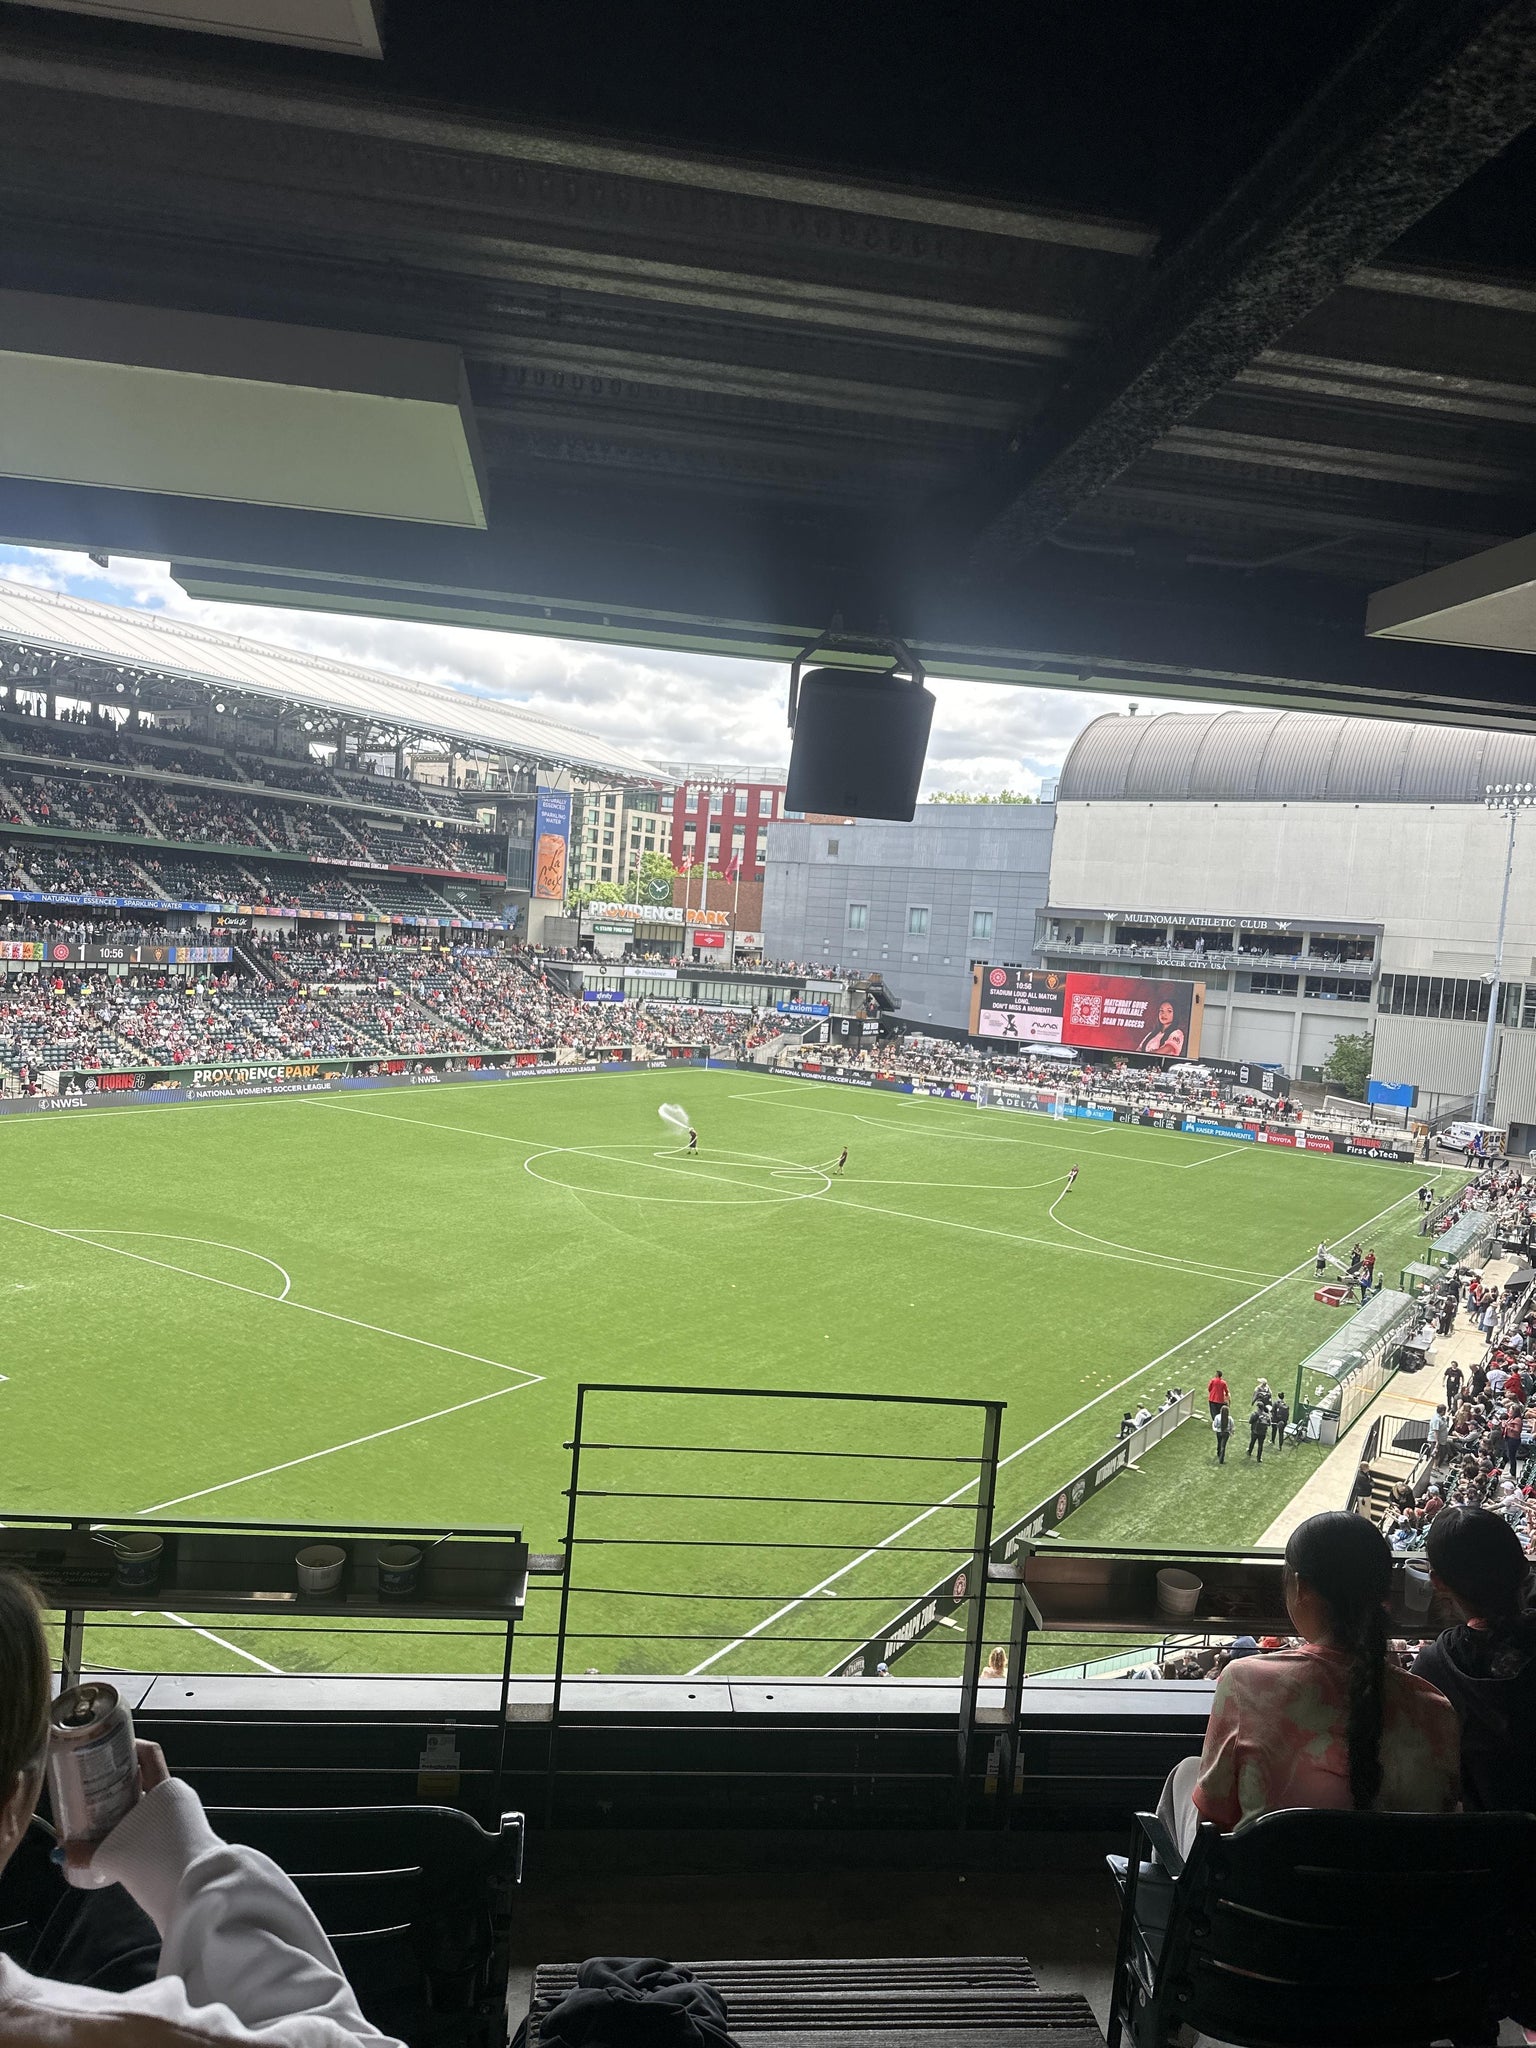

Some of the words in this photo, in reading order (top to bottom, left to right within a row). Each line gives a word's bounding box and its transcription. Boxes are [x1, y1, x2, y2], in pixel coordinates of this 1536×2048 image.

[350, 860, 370, 868] CHRISTINE
[42, 894, 80, 903] NATURALLY
[84, 896, 118, 905] ESSENCED
[124, 900, 158, 908] SPARKLING
[161, 902, 183, 910] WATER
[588, 900, 684, 922] PROVIDENCE
[686, 908, 730, 926] PARK
[1124, 913, 1186, 925] MULTNOMAH
[1190, 917, 1236, 928] ATHLETIC
[1240, 920, 1268, 929] CLUB
[100, 948, 124, 959] 10:56
[1156, 959, 1186, 967] SOCCER
[1189, 960, 1207, 969] CITY
[1016, 982, 1032, 990] 10:56
[596, 992, 612, 1000] xfinity
[990, 988, 1012, 996] STADIUM
[1013, 990, 1027, 998] LOUD
[790, 1004, 812, 1012] axiom
[1104, 998, 1132, 1008] MATCHDAY
[1132, 1000, 1148, 1010] GUIDE
[1103, 1006, 1116, 1014] NOW
[1116, 1007, 1144, 1016] AVAILABLE
[1102, 1017, 1116, 1025] SCAN
[1117, 1018, 1124, 1026] TO
[1124, 1019, 1145, 1028] ACCESS
[193, 1066, 284, 1082] PROVIDENCE
[285, 1064, 320, 1078] PARK
[774, 1068, 800, 1077] NATIONAL
[801, 1072, 826, 1080] WOMEN'S
[849, 1078, 872, 1086] LEAGUE
[96, 1073, 134, 1089] THORNS
[132, 1072, 146, 1089] FC
[418, 1076, 441, 1084] NWSL
[196, 1089, 235, 1098] NATIONAL
[236, 1086, 272, 1095] WOMEN'S
[273, 1084, 302, 1093] SOCCER
[303, 1083, 331, 1091] LEAGUE
[931, 1088, 946, 1097] ally
[950, 1091, 964, 1100] ally
[51, 1098, 87, 1109] NWSL
[1006, 1098, 1039, 1110] DELTA
[1120, 1114, 1130, 1123] elf
[1153, 1119, 1166, 1128] elf
[1196, 1127, 1214, 1135] KAISER
[1269, 1136, 1292, 1144] TOYOTA
[1306, 1133, 1329, 1141] TOYOTA
[1308, 1141, 1331, 1149] TOYOTA
[1353, 1137, 1381, 1148] THORNS
[1347, 1146, 1366, 1155] First
[1379, 1148, 1398, 1160] Tech
[1031, 1513, 1044, 1538] ZONE
[920, 1600, 937, 1630] ZONE
